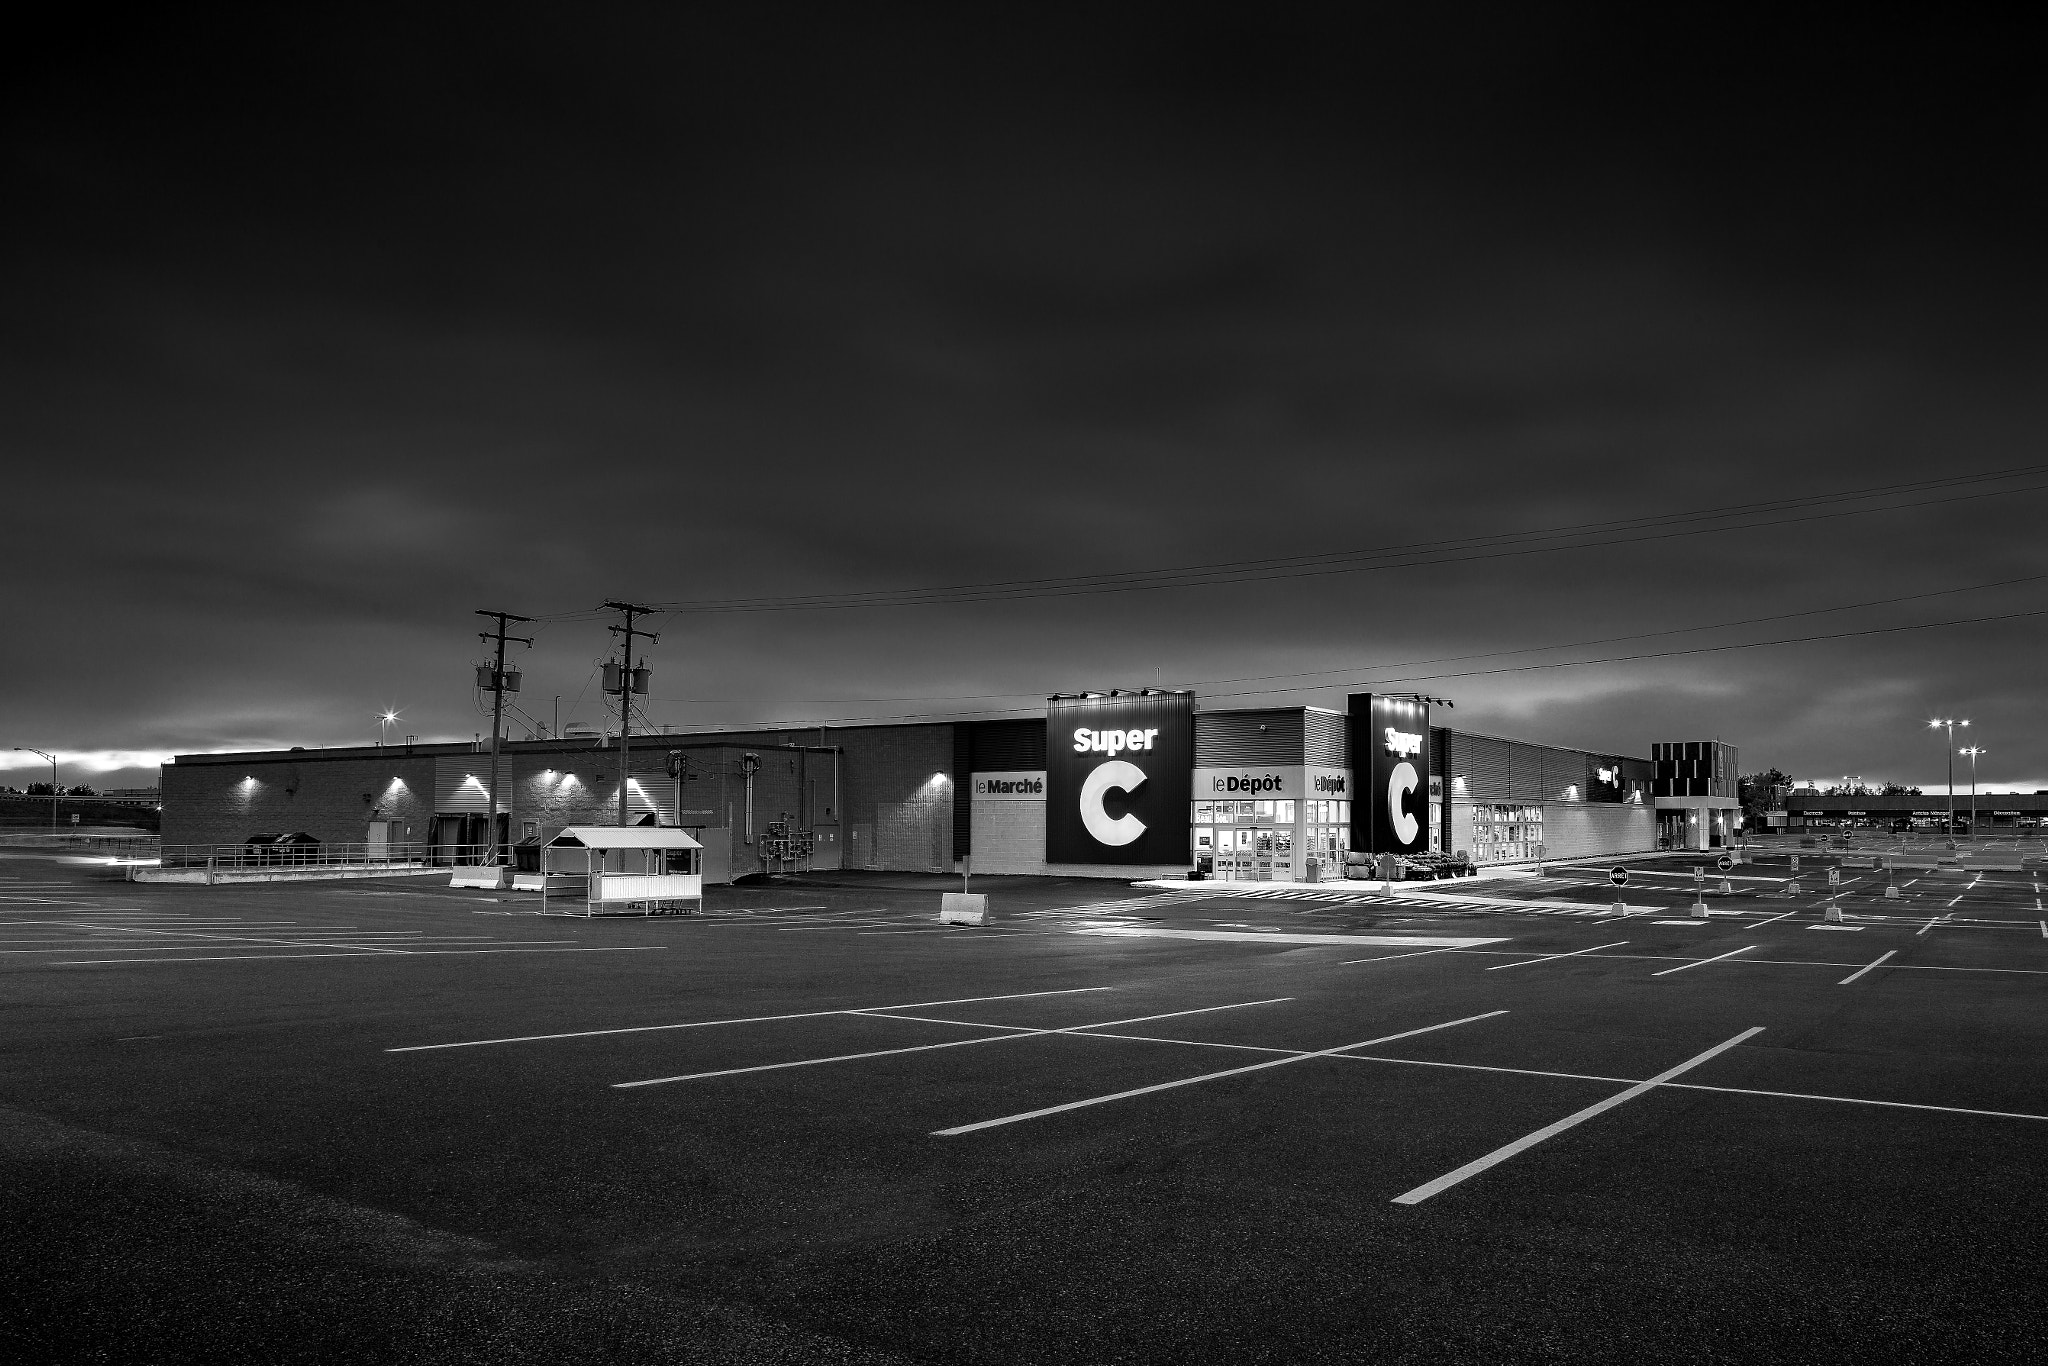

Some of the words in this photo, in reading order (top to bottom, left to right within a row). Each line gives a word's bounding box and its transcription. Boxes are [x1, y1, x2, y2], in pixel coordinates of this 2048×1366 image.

[1074, 728, 1158, 756] Super
[1385, 727, 1423, 758] Super
[975, 779, 986, 794] le
[987, 777, 1043, 794] Marché
[1213, 776, 1225, 792] le
[1226, 774, 1283, 795] Dépôt
[1314, 775, 1321, 792] le
[1320, 775, 1346, 796] Dépôt
[1430, 781, 1442, 797] ché
[1080, 760, 1148, 846] C
[1388, 762, 1419, 844] C
[1610, 872, 1628, 881] ARRÊT
